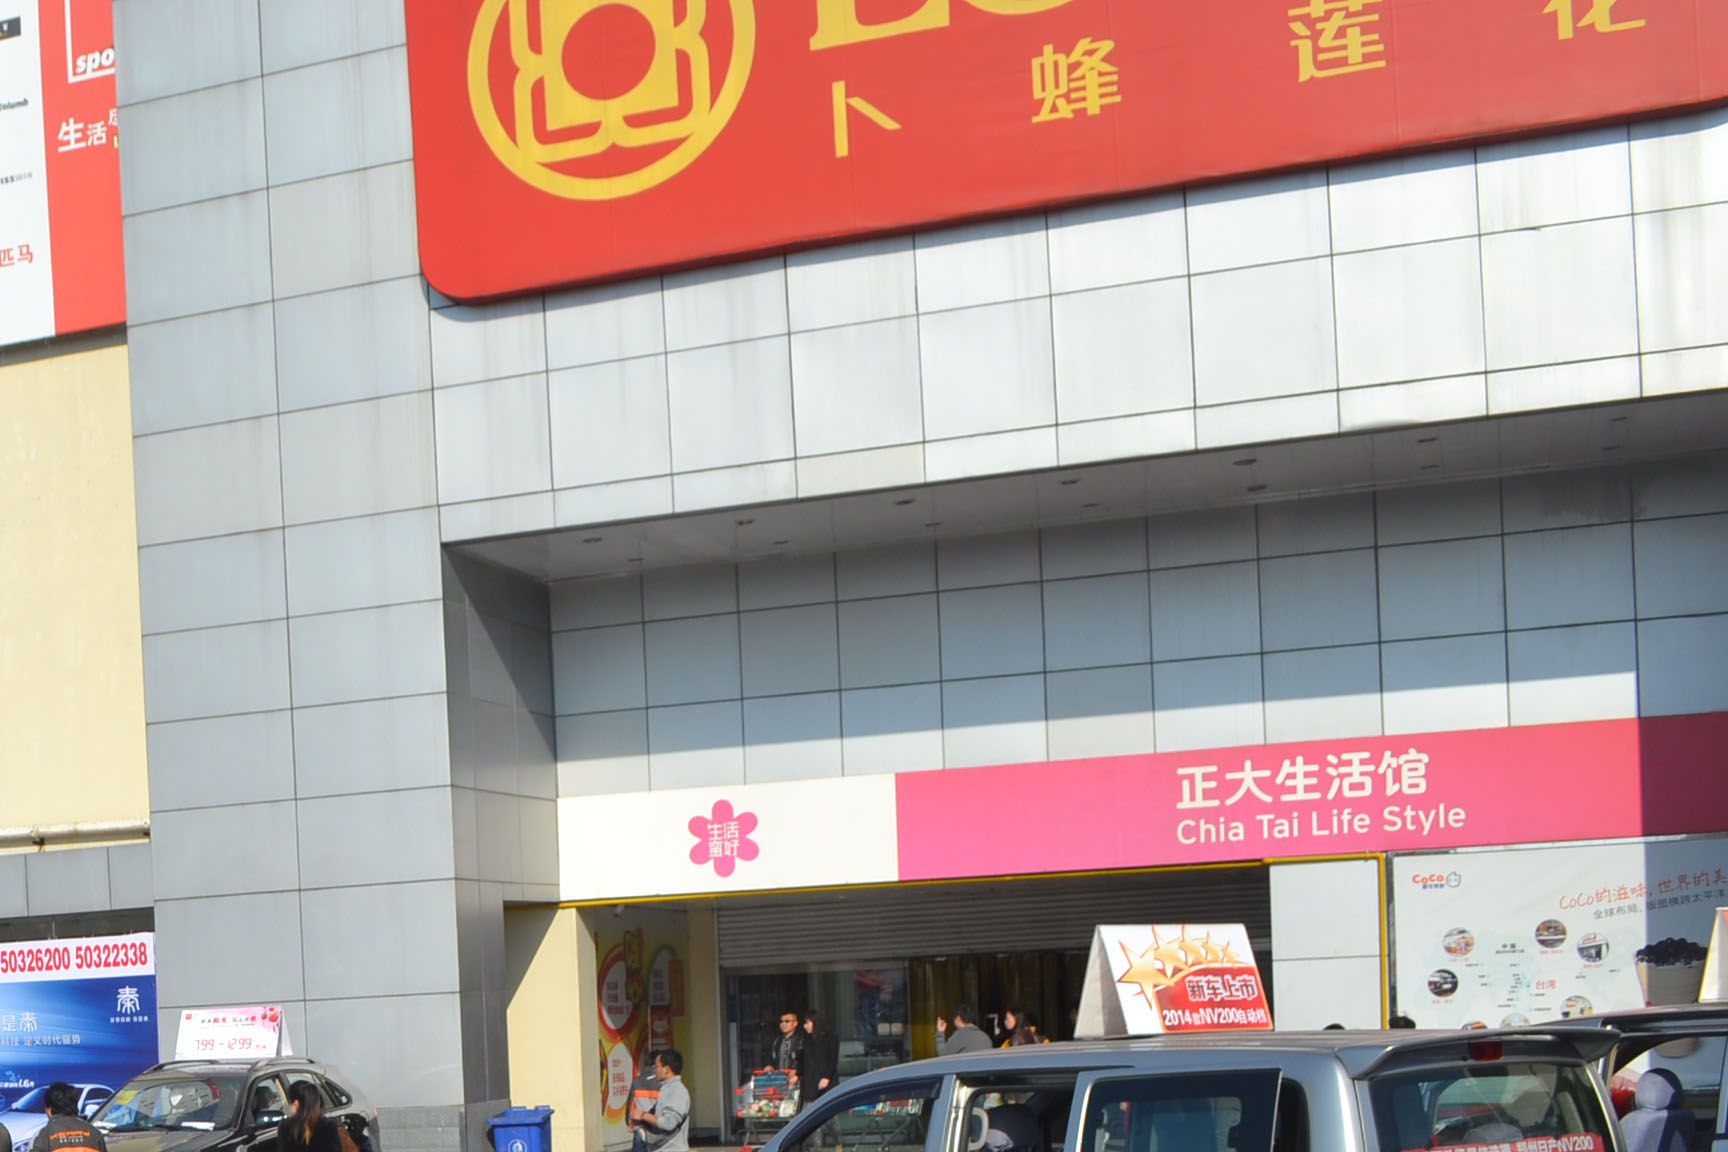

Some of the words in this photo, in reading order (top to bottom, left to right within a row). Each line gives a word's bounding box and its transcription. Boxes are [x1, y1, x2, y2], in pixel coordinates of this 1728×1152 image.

[1175, 747, 1430, 810] 正大生活馆
[1176, 816, 1245, 845] Chia
[1256, 811, 1300, 840] Tai
[1312, 808, 1371, 836] Life
[1383, 802, 1467, 836] Style
[0, 946, 71, 974] 50326200
[75, 941, 148, 970] 50322338
[1185, 975, 1259, 1002] 新车上市
